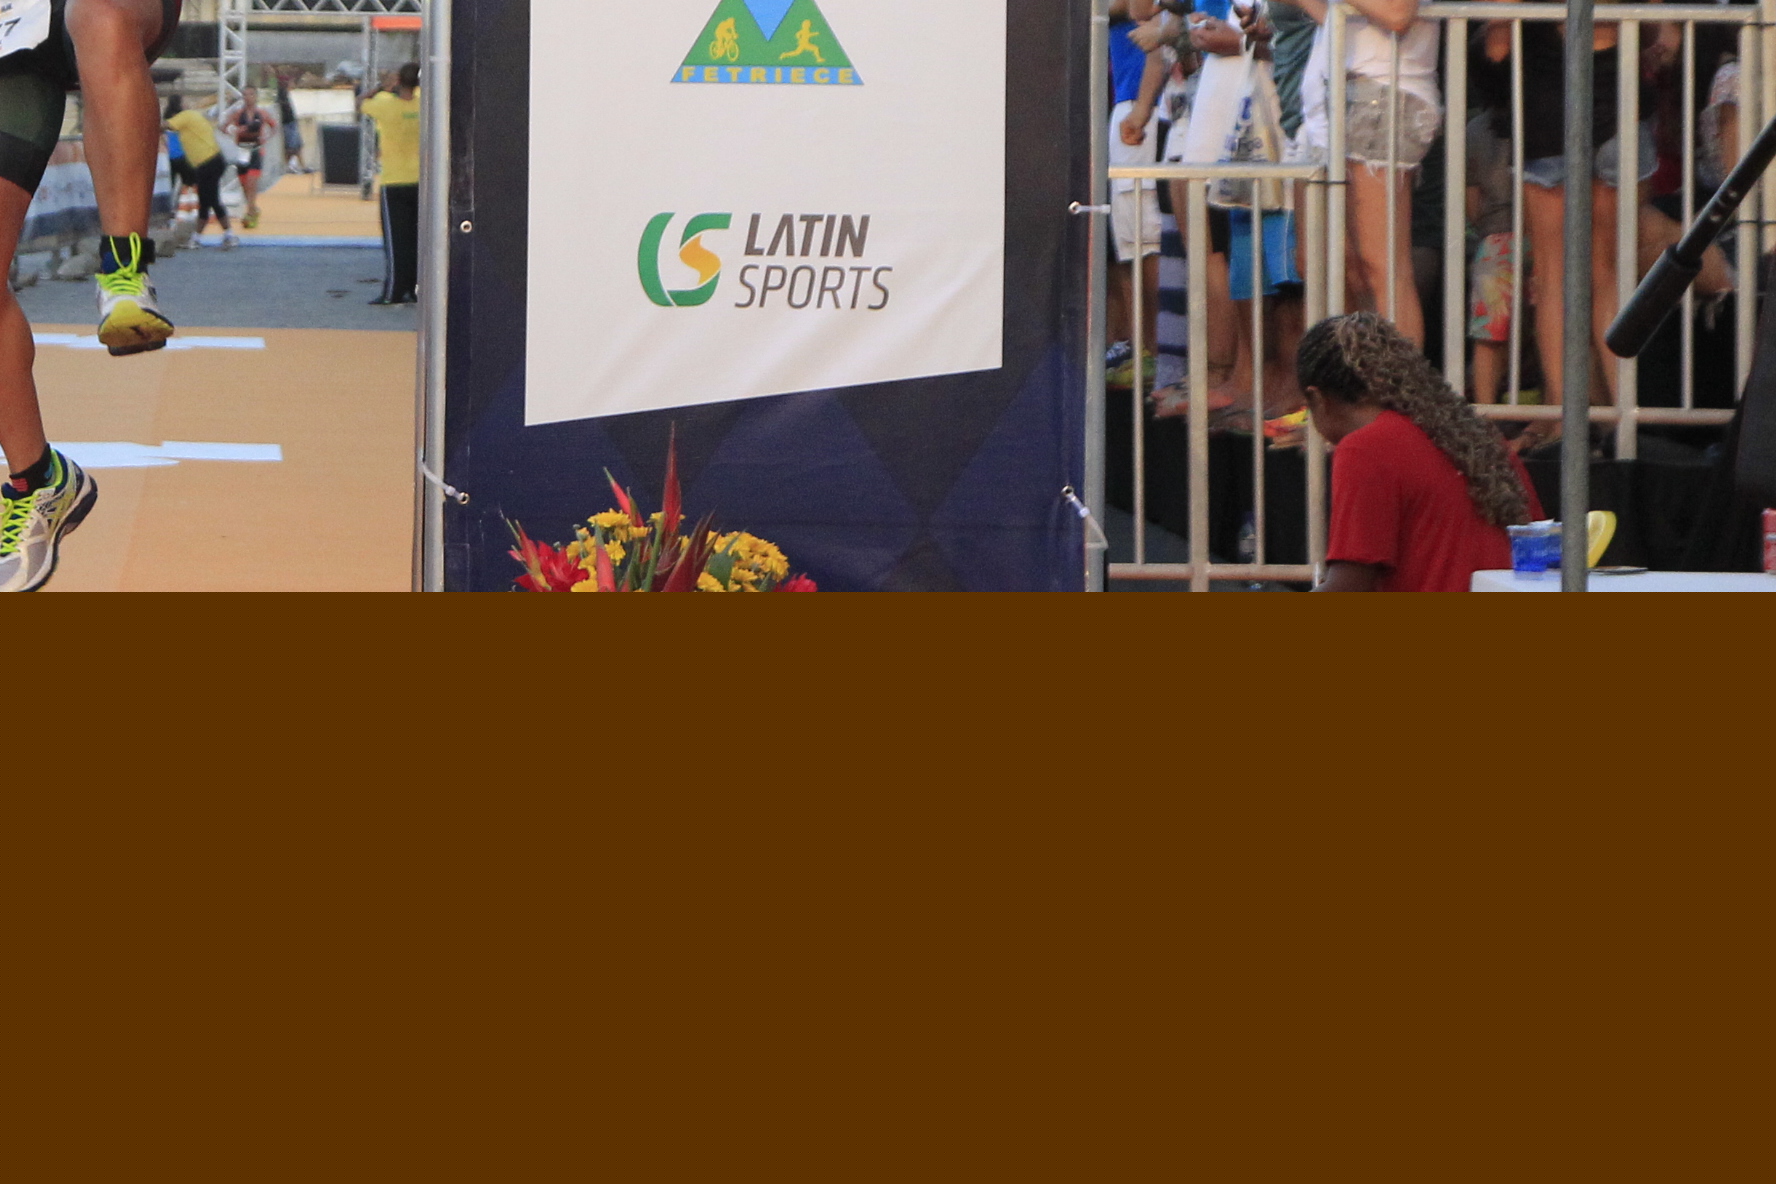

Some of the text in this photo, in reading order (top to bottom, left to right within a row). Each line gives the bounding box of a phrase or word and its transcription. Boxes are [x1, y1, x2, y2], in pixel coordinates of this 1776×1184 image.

[681, 66, 855, 83] FETRIECE
[744, 213, 870, 258] LATIN
[734, 264, 893, 311] SPORTS
